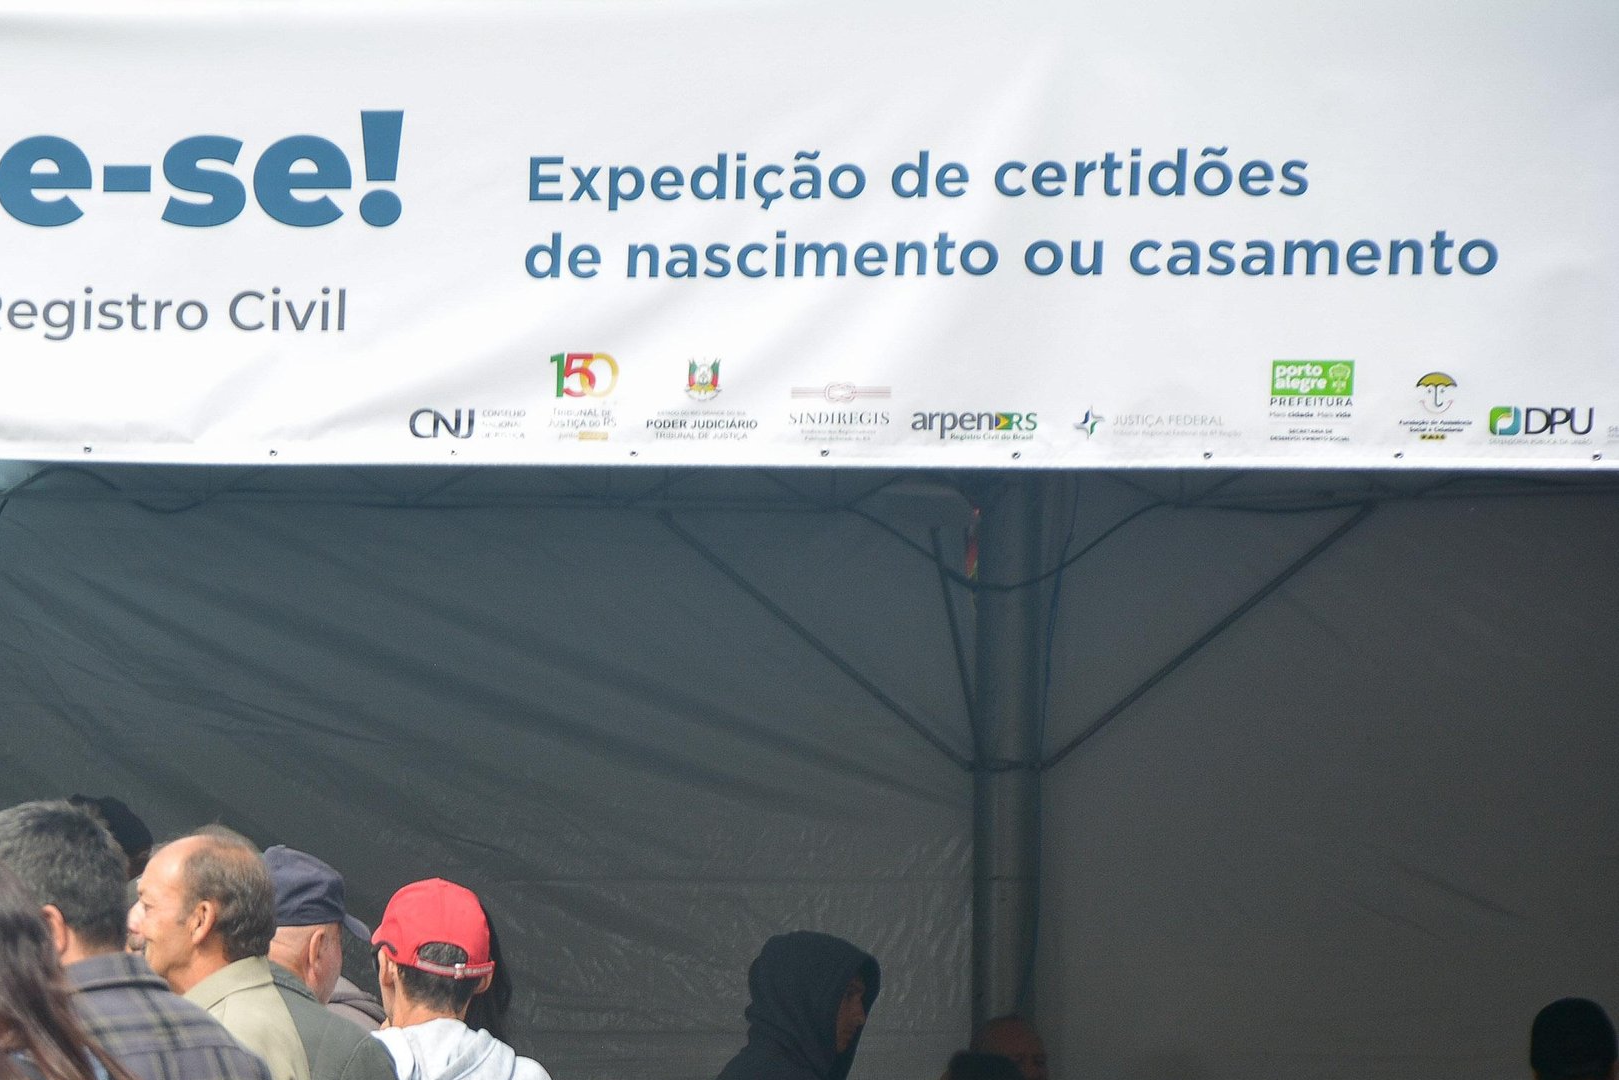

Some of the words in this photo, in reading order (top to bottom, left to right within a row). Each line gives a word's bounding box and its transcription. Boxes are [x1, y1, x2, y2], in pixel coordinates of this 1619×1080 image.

[529, 151, 866, 211] Expedição
[892, 151, 969, 198] de
[995, 147, 1308, 197] certidões
[525, 232, 601, 279] de
[627, 231, 998, 278] nascimento
[1025, 240, 1103, 276] ou
[1130, 231, 1498, 276] casamento
[229, 287, 346, 331] Civil
[550, 352, 620, 398] 150
[1275, 363, 1323, 378] porto
[1275, 376, 1327, 393] alegre
[1269, 397, 1353, 407] PREFEITURA
[409, 407, 475, 439] CNJ
[646, 419, 687, 429] PODER
[691, 417, 758, 429] JUDICIÁRIO
[789, 411, 890, 425] SINDIREGIS
[1112, 414, 1164, 428] JUSTIÇA
[1168, 414, 1224, 426] FEDERAL
[1524, 406, 1595, 435] DPU
